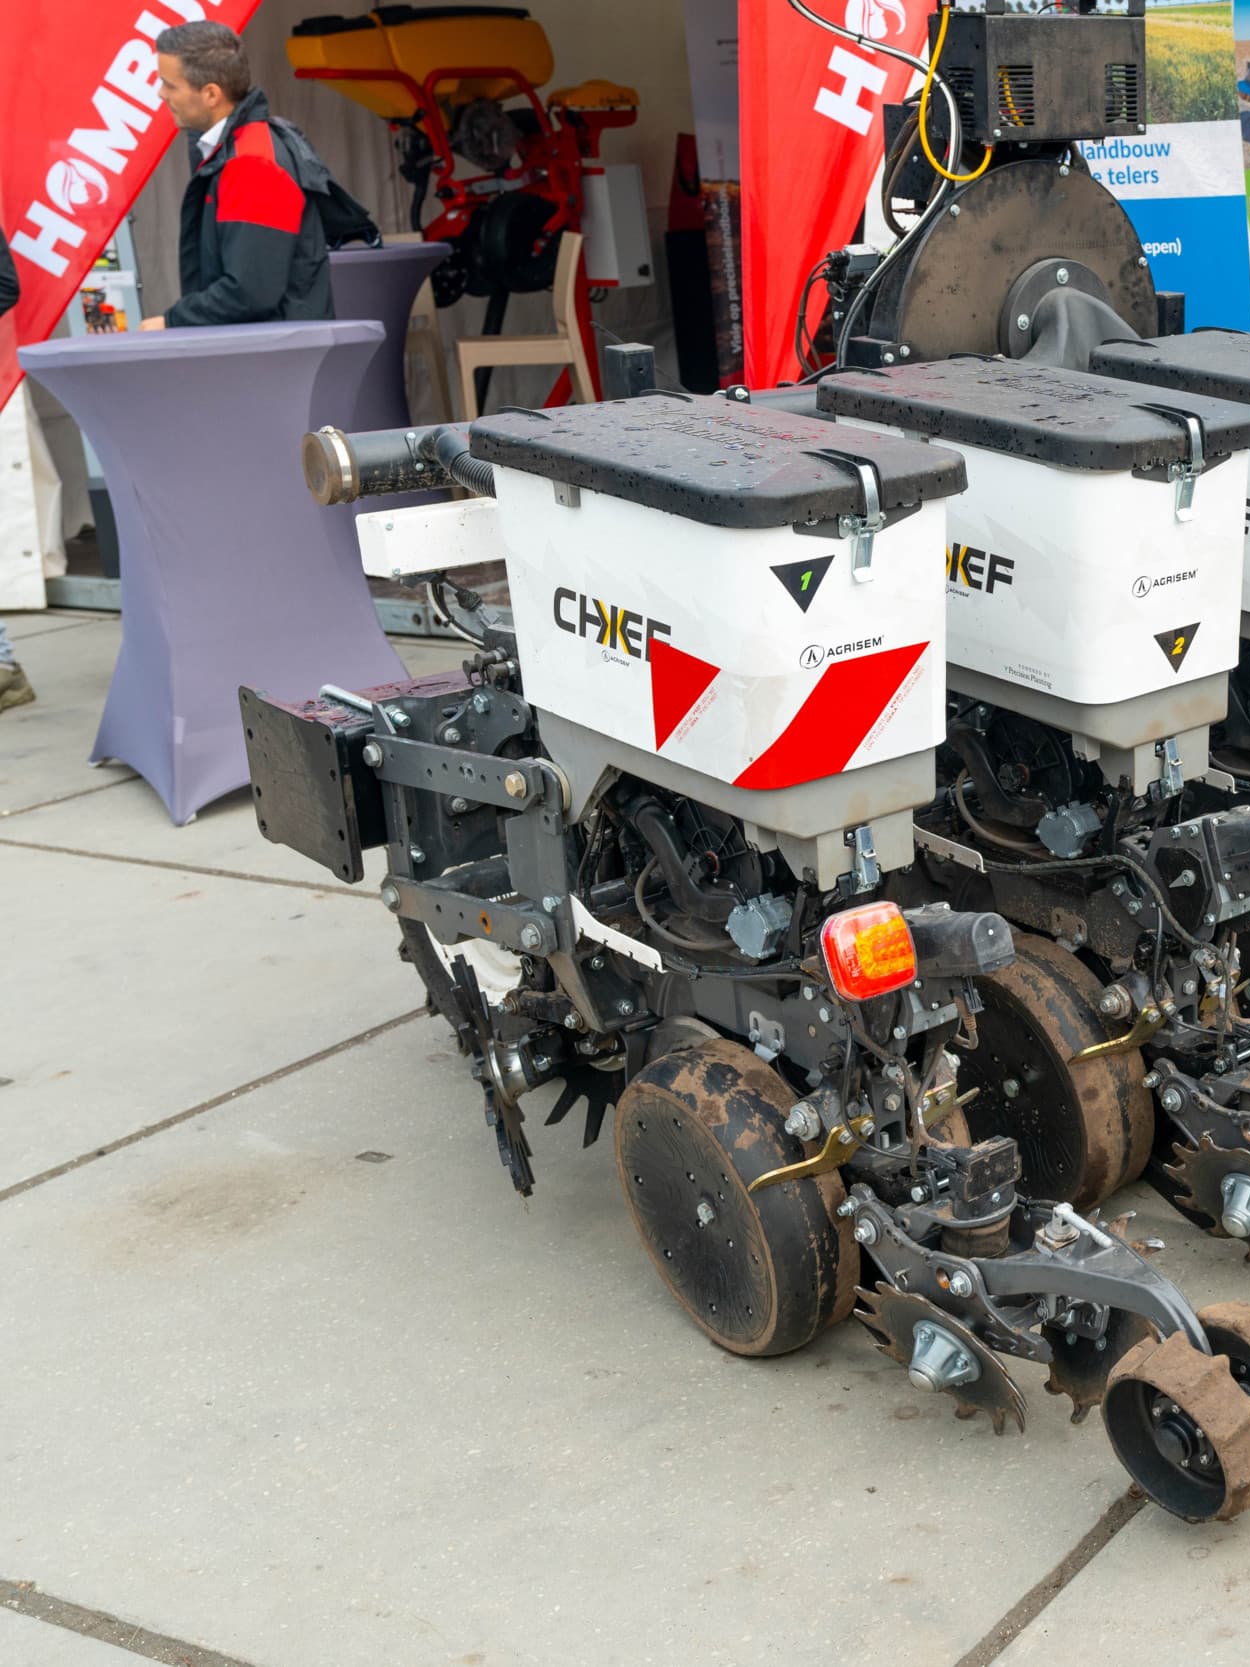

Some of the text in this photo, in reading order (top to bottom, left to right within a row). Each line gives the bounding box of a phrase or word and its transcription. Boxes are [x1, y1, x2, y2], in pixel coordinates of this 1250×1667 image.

[1108, 165, 1159, 185] telers
[1141, 237, 1182, 257] epen)
[729, 303, 740, 321] op
[730, 322, 742, 354] Visie
[801, 571, 813, 591] 1
[1153, 569, 1197, 588] AGRISEM
[827, 636, 883, 658] AGRISEM
[1171, 636, 1185, 656] 2
